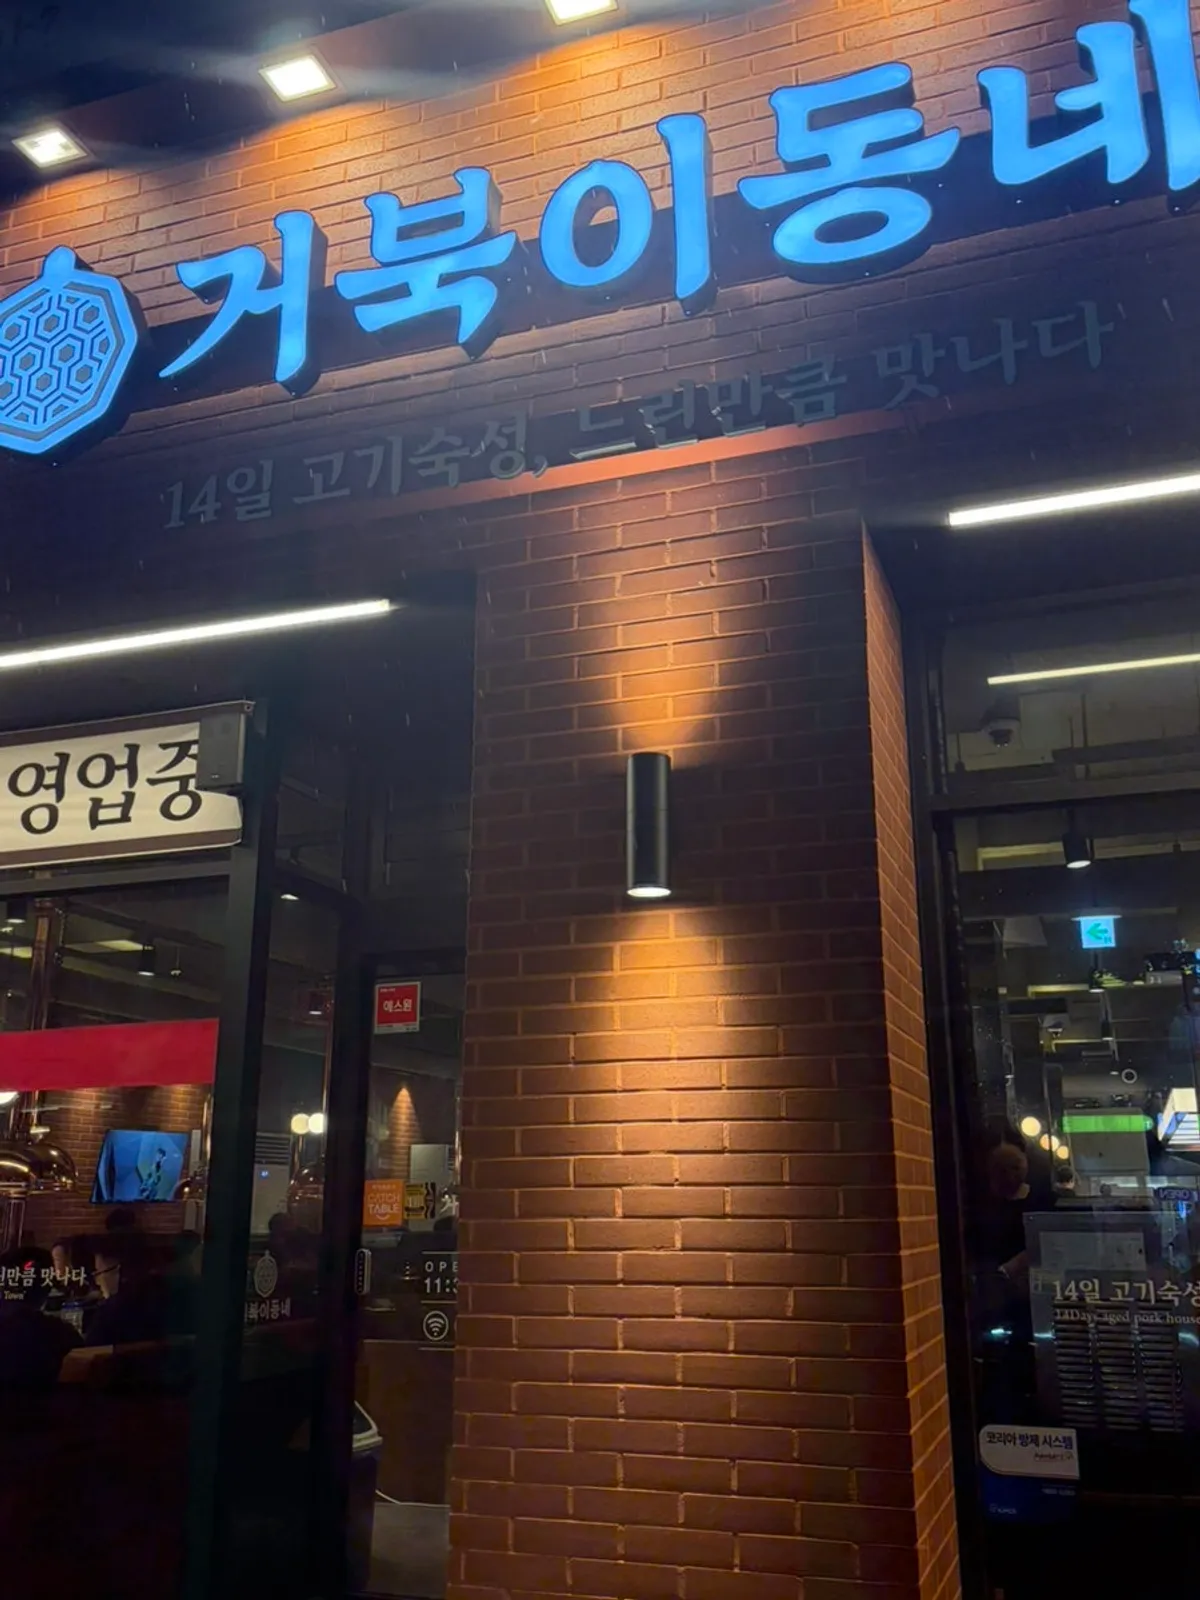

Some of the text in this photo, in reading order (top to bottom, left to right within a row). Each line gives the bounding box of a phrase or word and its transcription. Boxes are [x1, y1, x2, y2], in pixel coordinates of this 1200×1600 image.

[159, 0, 1200, 384] 거북이동네
[163, 300, 1117, 530] 14일 고기숙성, 느린만큼 맛나다
[7, 738, 203, 835] 영업중
[367, 1192, 400, 1204] CATCH
[367, 1203, 401, 1214] TABLE
[40, 1266, 88, 1287] 맛나다
[1051, 1278, 1102, 1305] 14일
[1133, 1312, 1165, 1328] pork
[986, 1431, 1016, 1447] 코리아
[1042, 1435, 1073, 1450] 시스템
